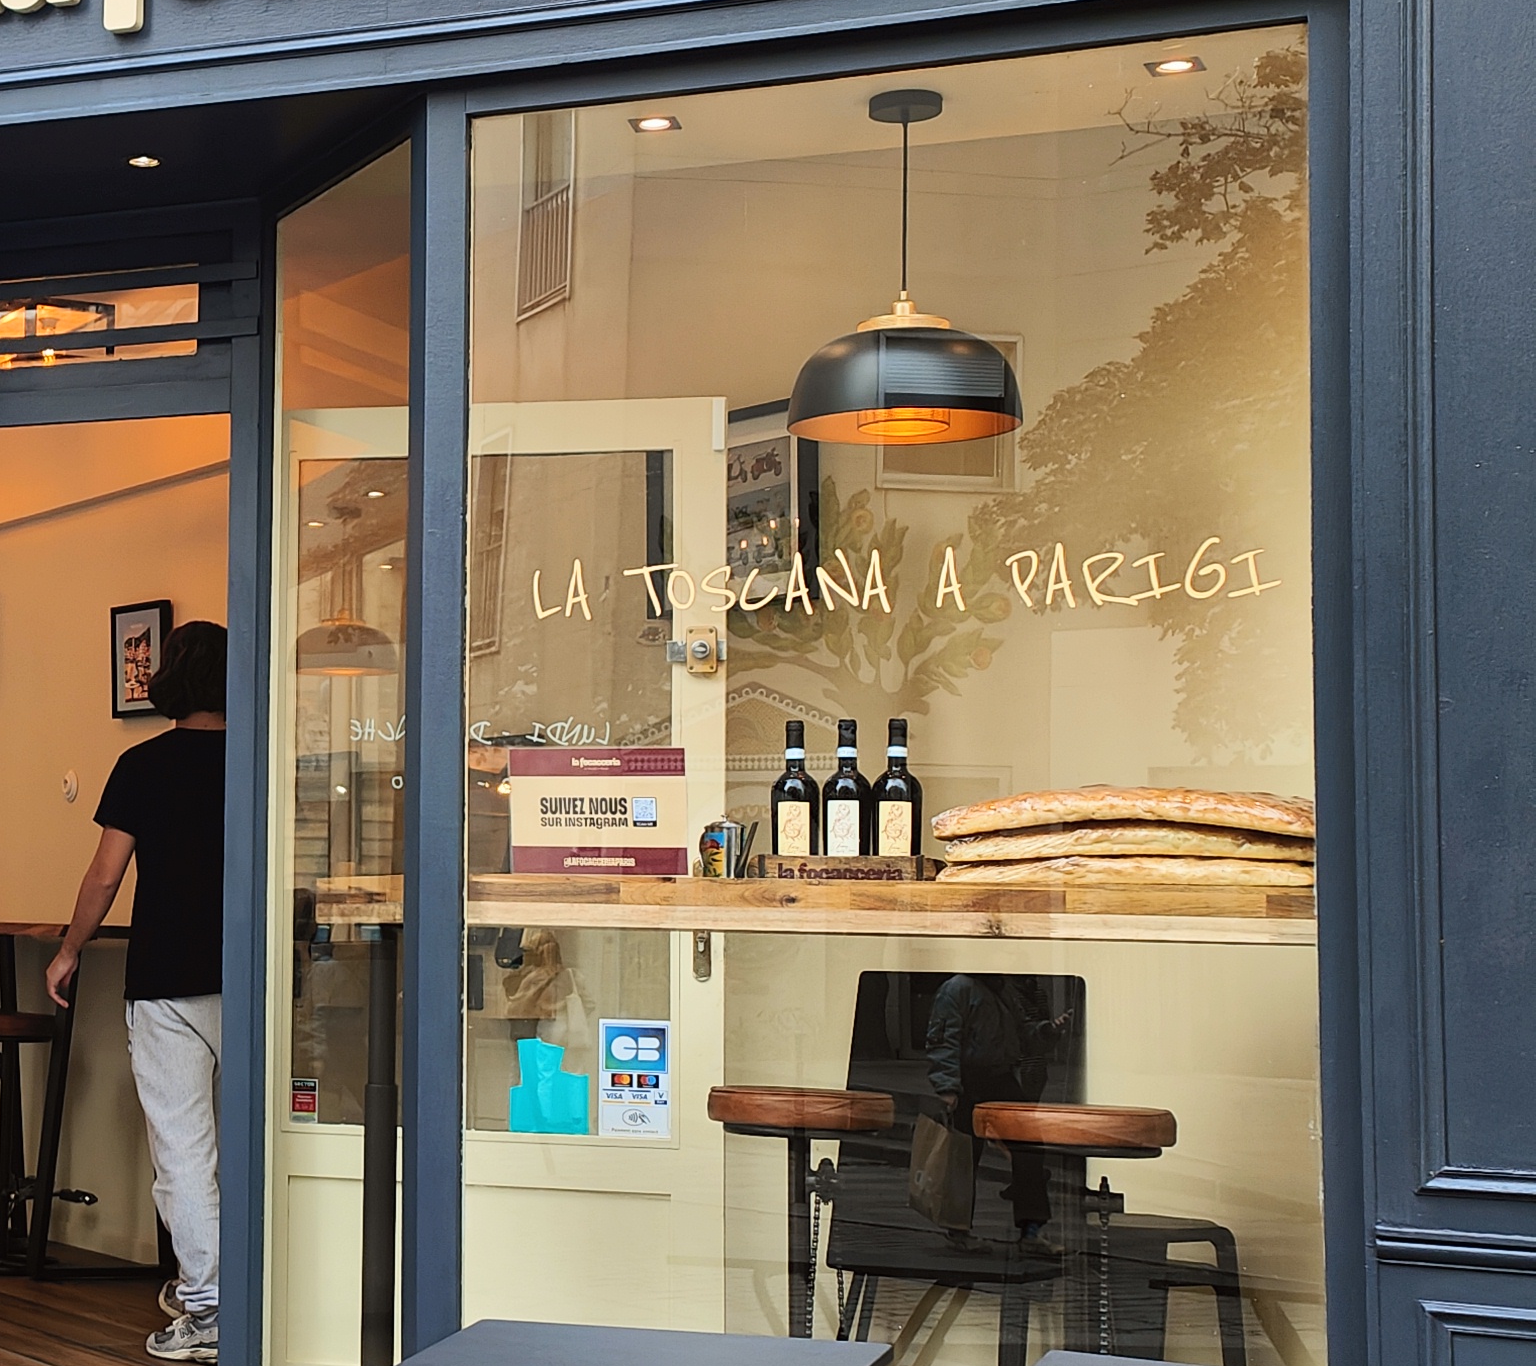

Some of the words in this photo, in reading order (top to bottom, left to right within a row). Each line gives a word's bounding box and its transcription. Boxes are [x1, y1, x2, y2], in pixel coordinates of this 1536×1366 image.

[532, 557, 593, 621] LA
[622, 547, 893, 617] TOSCANA
[935, 545, 967, 612] A
[1004, 536, 1283, 609] PARIGI
[540, 796, 586, 816] SUIVEZ
[589, 796, 628, 816] NOUS
[540, 816, 563, 828] SUR
[777, 862, 795, 880] la
[797, 862, 904, 881] focacceria
[610, 1035, 660, 1062] CB
[605, 1092, 624, 1100] VISA
[631, 1092, 648, 1100] VISA
